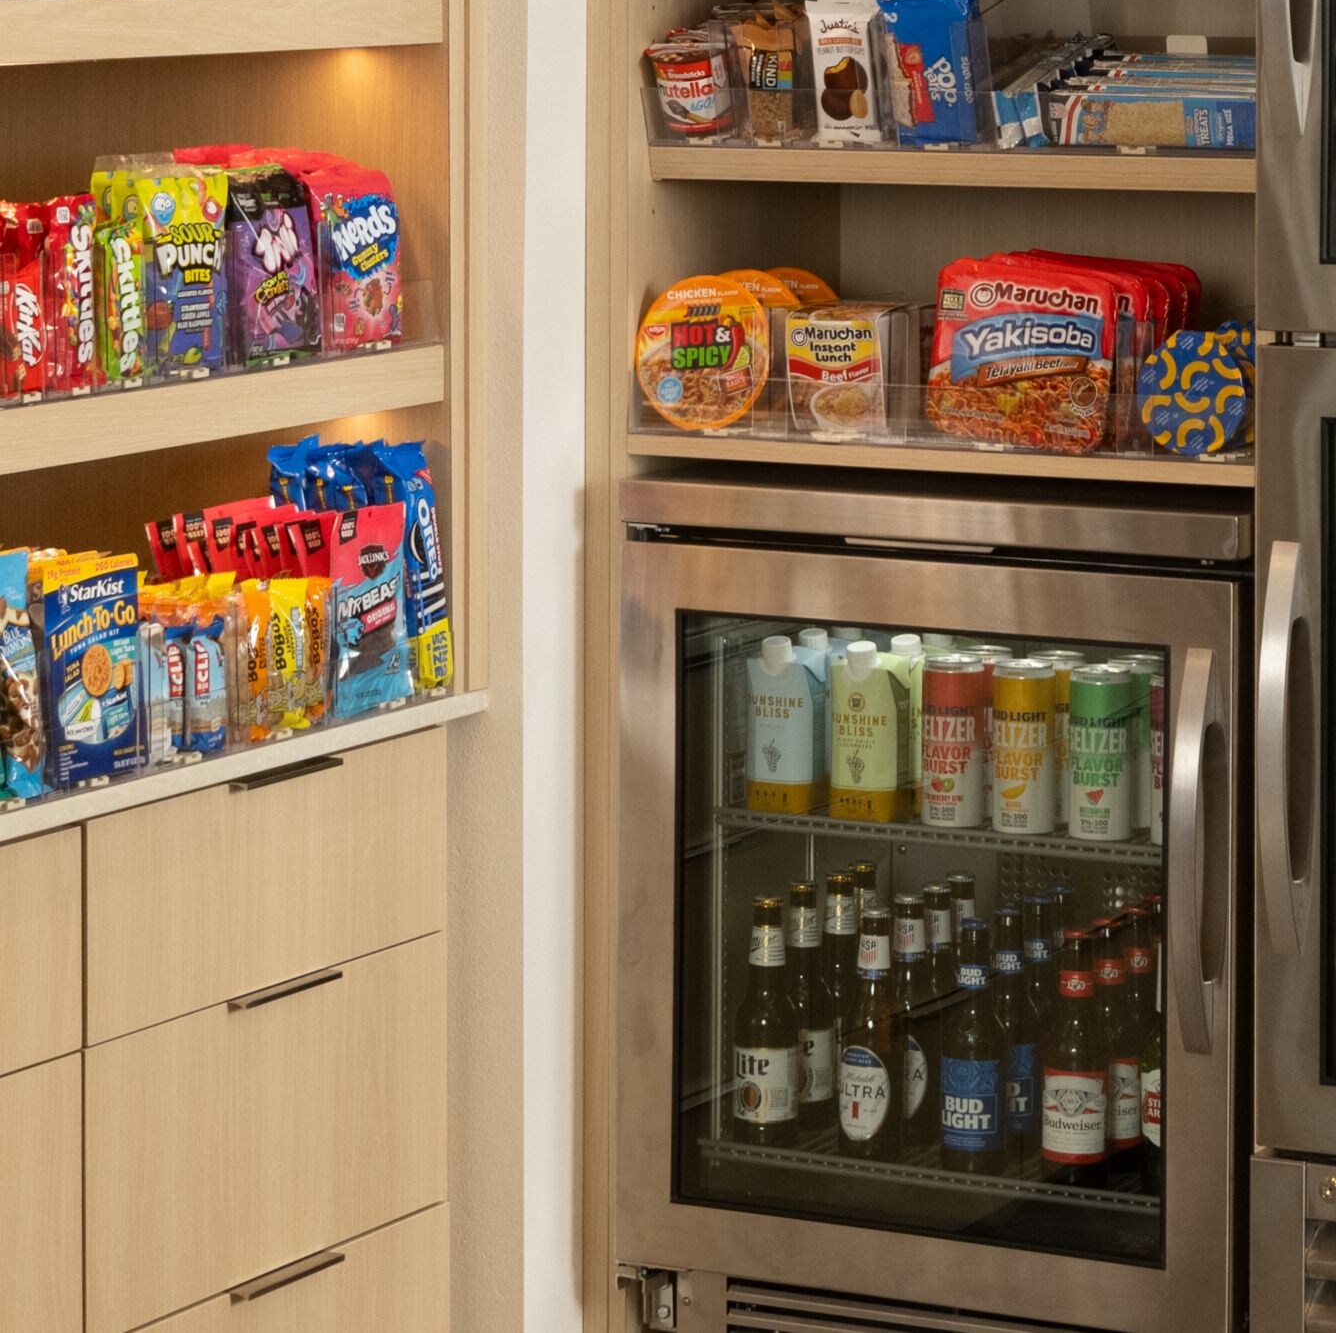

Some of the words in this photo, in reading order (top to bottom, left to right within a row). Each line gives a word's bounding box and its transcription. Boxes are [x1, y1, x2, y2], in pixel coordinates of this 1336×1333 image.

[817, 46, 835, 55] PEANUT
[766, 55, 777, 87] KIND
[932, 56, 957, 103] pop
[658, 82, 713, 98] nutella
[1200, 109, 1210, 144] TREATS
[169, 223, 216, 245] SOUR
[156, 241, 226, 276] PUNCH
[184, 269, 211, 283] BITES
[667, 288, 717, 300] CHICKEN
[994, 282, 1099, 314] Maruchan
[672, 324, 716, 347] HOT
[715, 327, 731, 343] &
[805, 327, 872, 340] Maruchan
[965, 322, 1093, 355] Yakisoba
[810, 342, 857, 353] Instant
[672, 345, 732, 369] SPICY
[815, 352, 852, 362] Lunch
[821, 369, 848, 381] Beef
[848, 367, 870, 379] Flavor
[986, 361, 1034, 378] Teriyaki
[1035, 358, 1060, 369] Beef
[341, 521, 355, 531] 100%
[305, 532, 321, 542] 100%
[341, 529, 354, 538] BEEF
[418, 498, 438, 581] OREO
[308, 540, 322, 548] BEEF
[70, 576, 124, 603] StarKist
[70, 641, 86, 655] TUNA
[88, 633, 107, 647] SALAD
[108, 628, 120, 638] KIT
[65, 661, 81, 674] TUNA
[64, 670, 81, 684] SALAD
[755, 706, 790, 719] BLISS
[1010, 712, 1047, 722] LIGHT
[924, 715, 975, 742] ELTZER
[1090, 717, 1126, 727] LIGHT
[839, 725, 873, 737] BLISS
[995, 721, 1046, 748] ELTZER
[1073, 772, 1120, 787] BURST
[861, 940, 876, 951] USA
[993, 961, 1021, 970] LIGHT
[996, 954, 1017, 963] BUD
[960, 967, 982, 977] BUD
[957, 976, 986, 986] LIGHT
[945, 1096, 984, 1114] BUD
[942, 1110, 991, 1130] LIGHT
